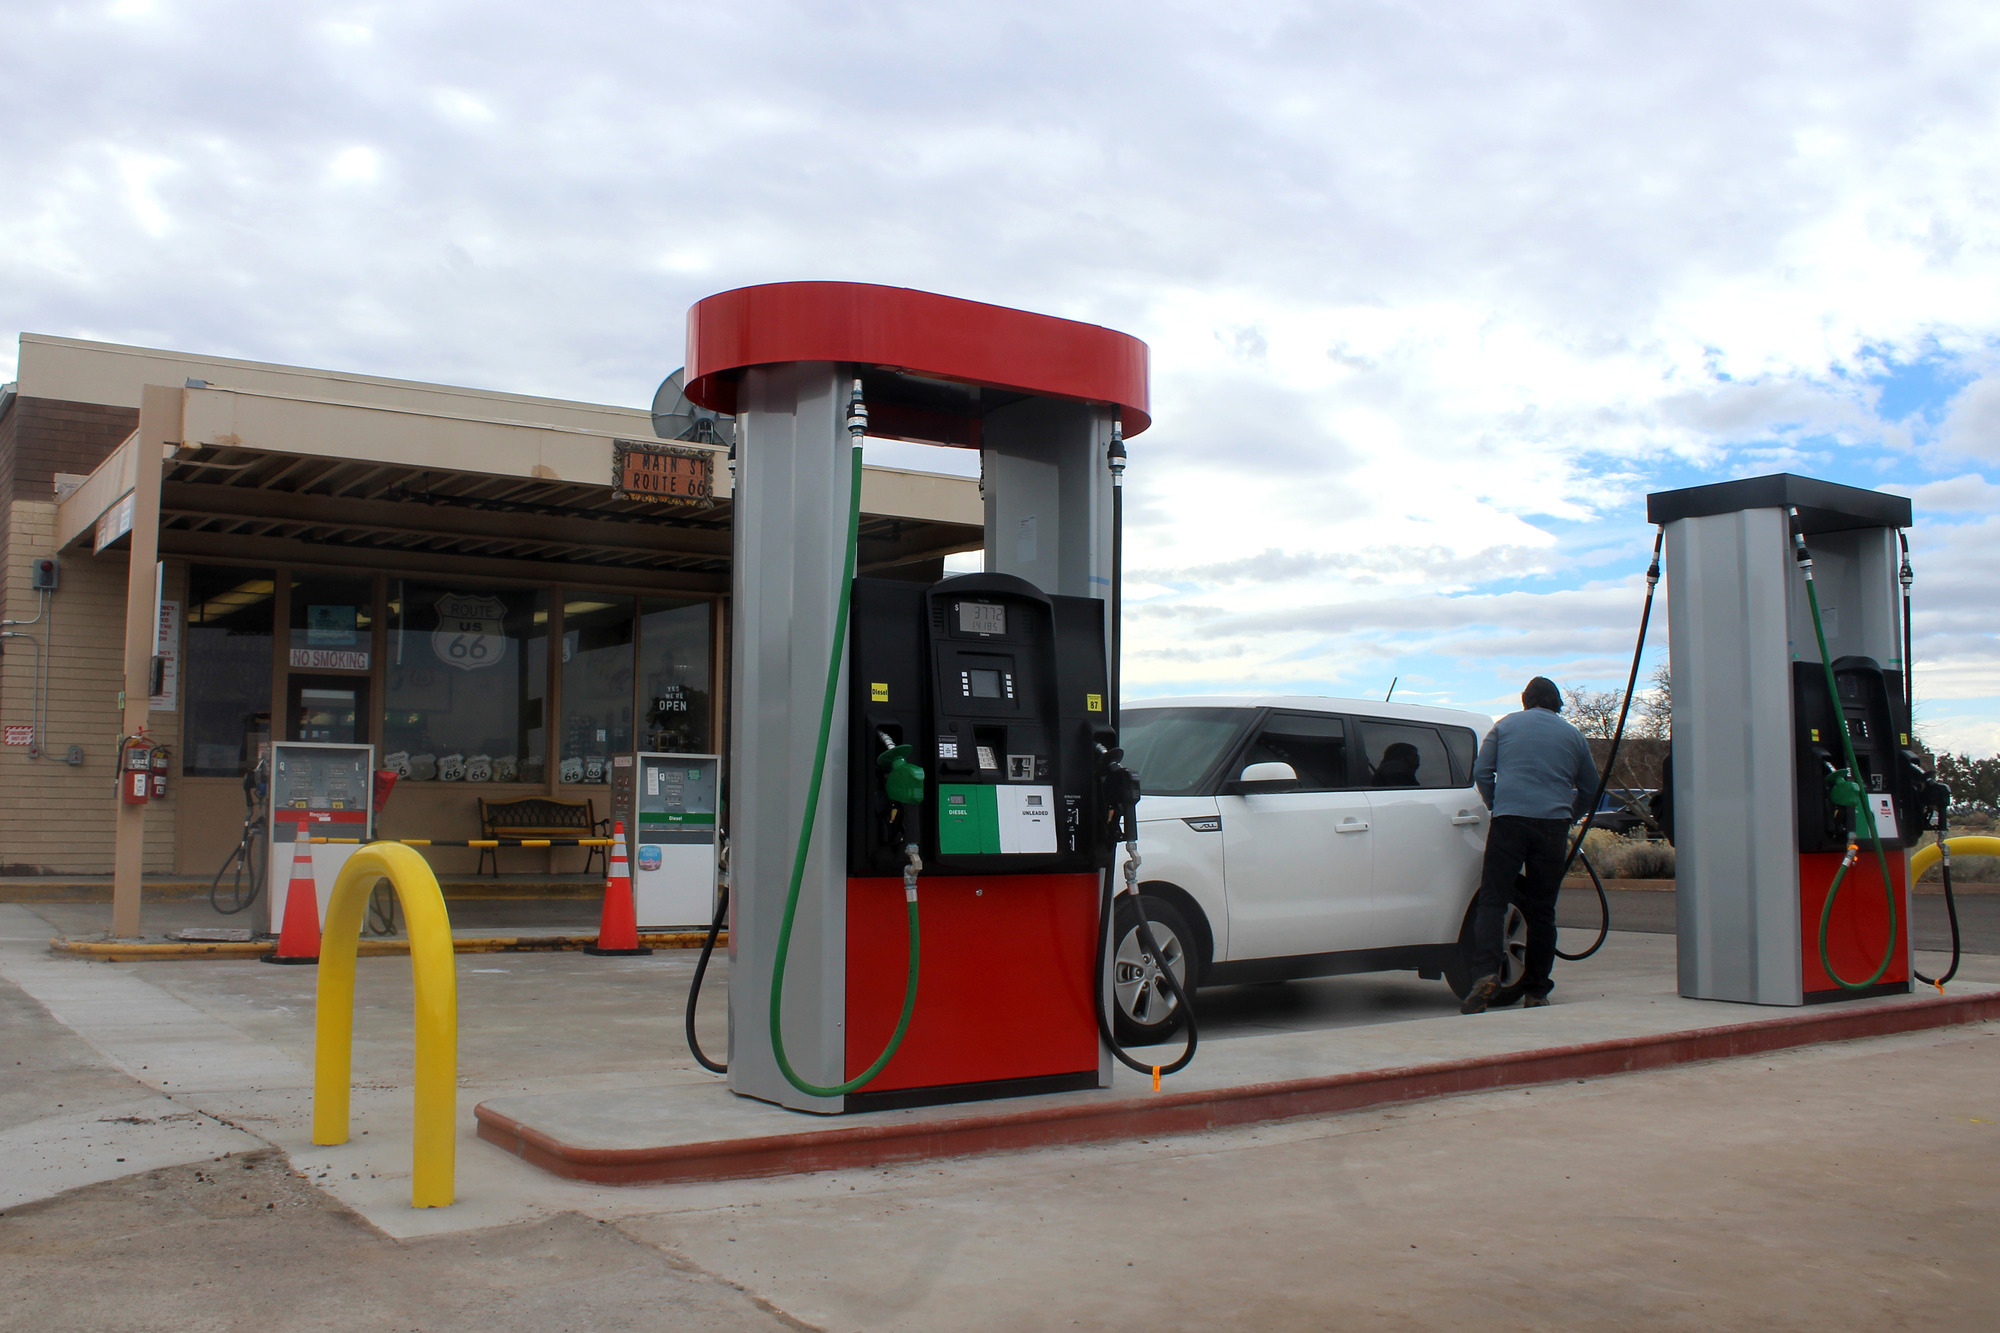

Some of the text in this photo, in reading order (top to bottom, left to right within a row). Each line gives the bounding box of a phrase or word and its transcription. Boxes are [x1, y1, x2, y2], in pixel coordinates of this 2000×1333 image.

[642, 453, 677, 473] MAIN
[689, 459, 706, 477] ST
[633, 472, 706, 497] ROUTE 66
[451, 603, 493, 618] ROUTE
[458, 622, 483, 633] US
[448, 634, 488, 660] 66
[293, 650, 366, 669] NO SMOKING
[872, 688, 888, 696] Diesel
[659, 701, 687, 711] OPEN
[1090, 701, 1099, 710] 87
[445, 768, 461, 780] 66
[471, 769, 487, 780] 66
[564, 771, 579, 782] 66
[588, 769, 600, 777] 66
[309, 811, 331, 819] Regular
